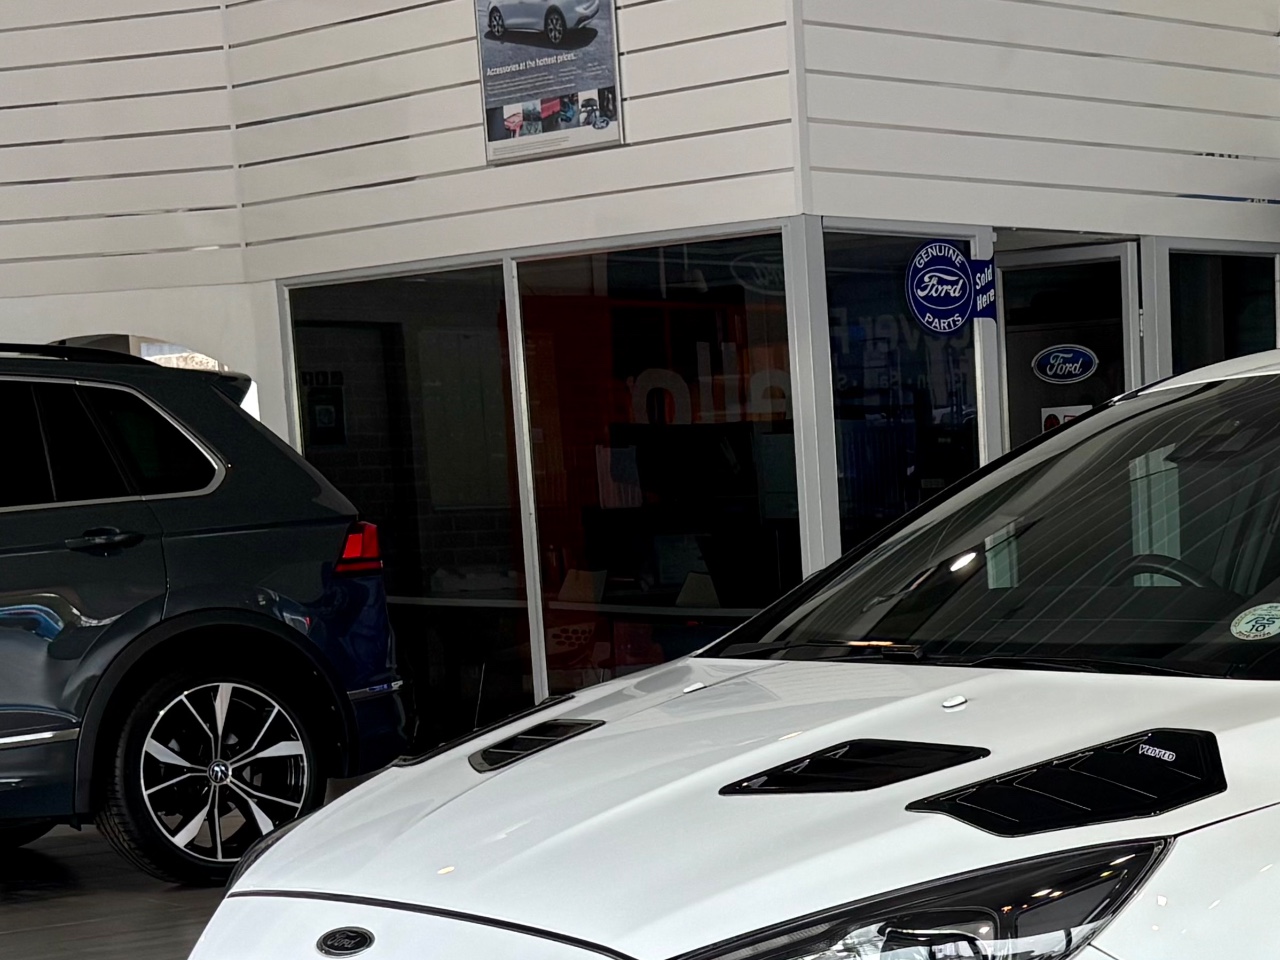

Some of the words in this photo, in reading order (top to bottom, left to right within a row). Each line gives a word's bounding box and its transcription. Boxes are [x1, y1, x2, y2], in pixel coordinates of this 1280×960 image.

[486, 63, 519, 76] Accessories
[519, 61, 526, 69] at
[526, 60, 536, 69] the
[536, 57, 557, 66] hottest
[915, 244, 964, 269] GENUINE
[917, 272, 964, 298] Ford
[975, 264, 993, 290] Sold
[976, 288, 995, 312] Here
[924, 312, 962, 331] PARTS
[1046, 352, 1083, 376] Ford
[1245, 616, 1280, 626] RS
[327, 930, 361, 948] Ford
